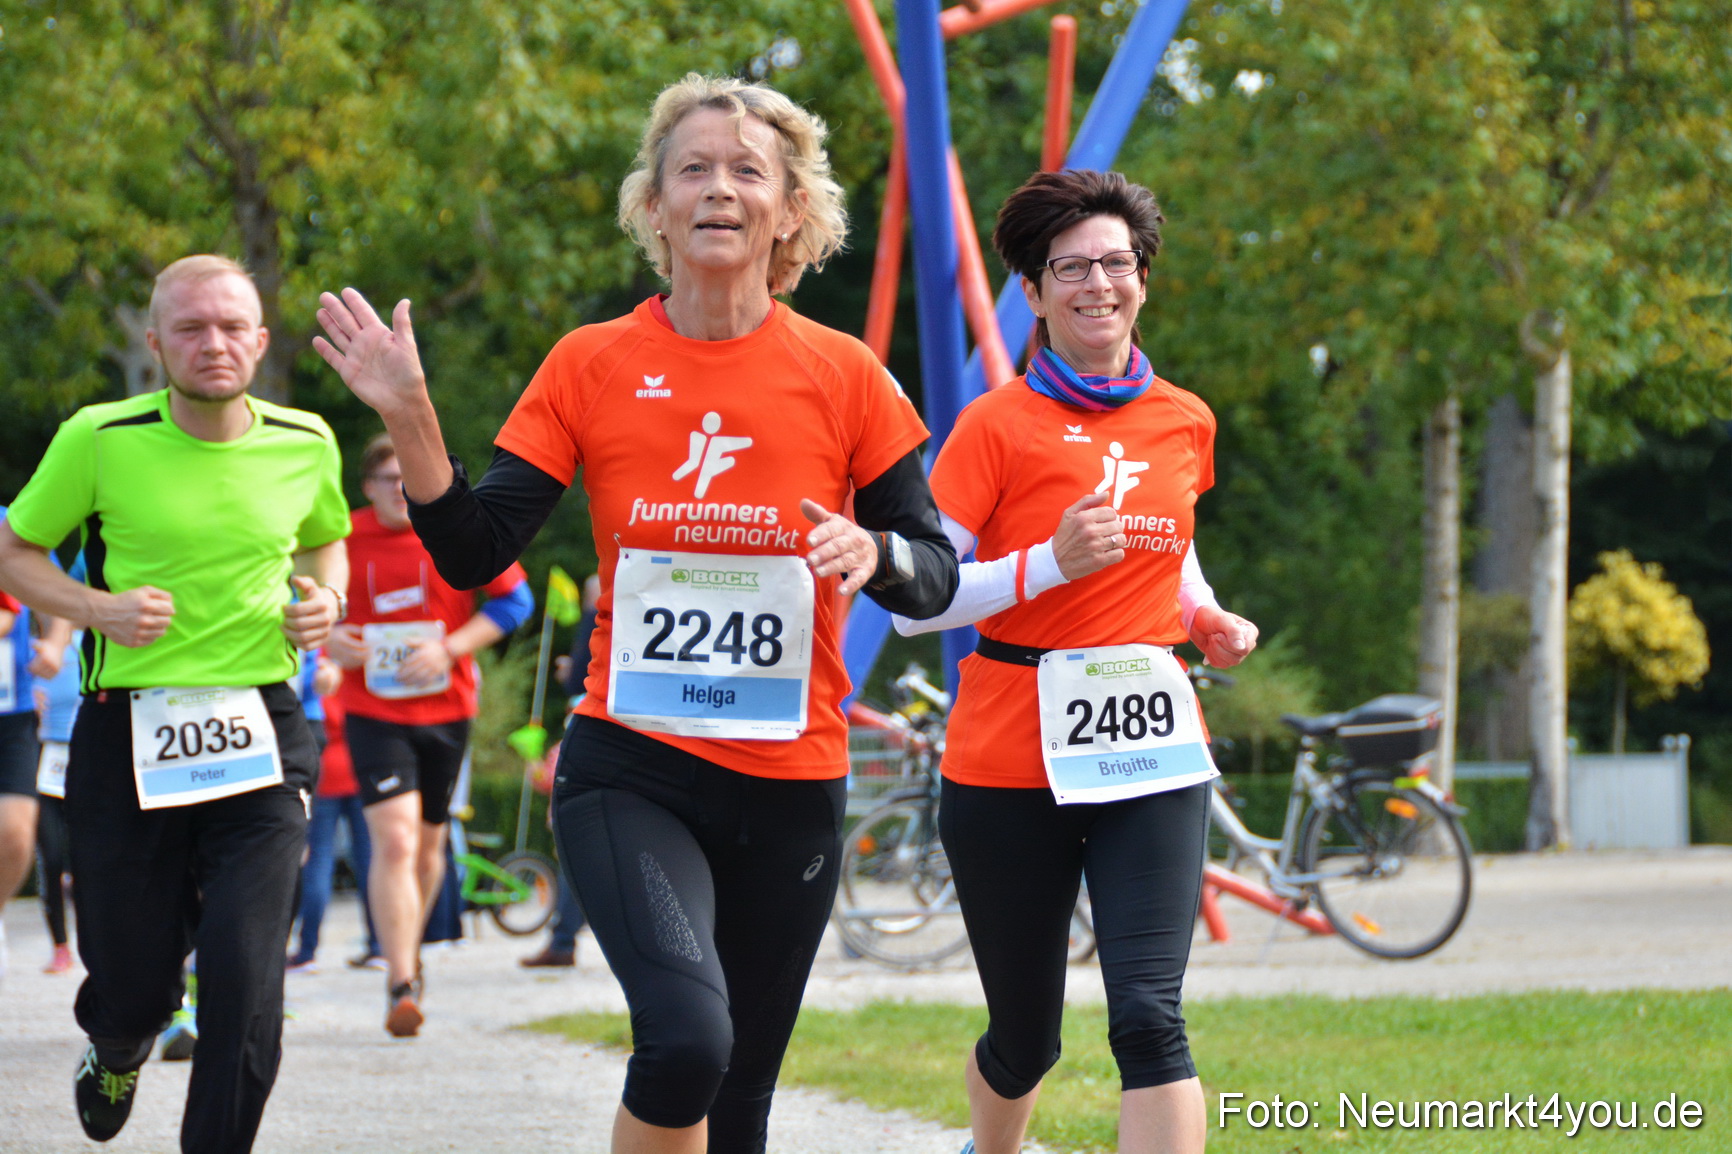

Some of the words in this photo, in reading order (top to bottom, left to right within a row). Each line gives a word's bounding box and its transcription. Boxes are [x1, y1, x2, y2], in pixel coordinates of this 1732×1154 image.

[636, 388, 672, 398] erima
[1063, 434, 1092, 443] erima
[628, 498, 778, 525] funrunners
[1116, 514, 1176, 534] nners
[674, 525, 799, 549] neumarkt
[1123, 534, 1186, 555] umarkt
[691, 569, 759, 587] BOCK
[642, 607, 783, 667] 2248
[622, 652, 630, 663] D
[1101, 657, 1151, 675] BOCK
[682, 684, 736, 708] Helga
[1066, 691, 1174, 746] 2489
[155, 716, 252, 762] 2035
[1051, 741, 1058, 751] D
[190, 768, 226, 783] Peter
[1098, 757, 1159, 776] Brigitte
